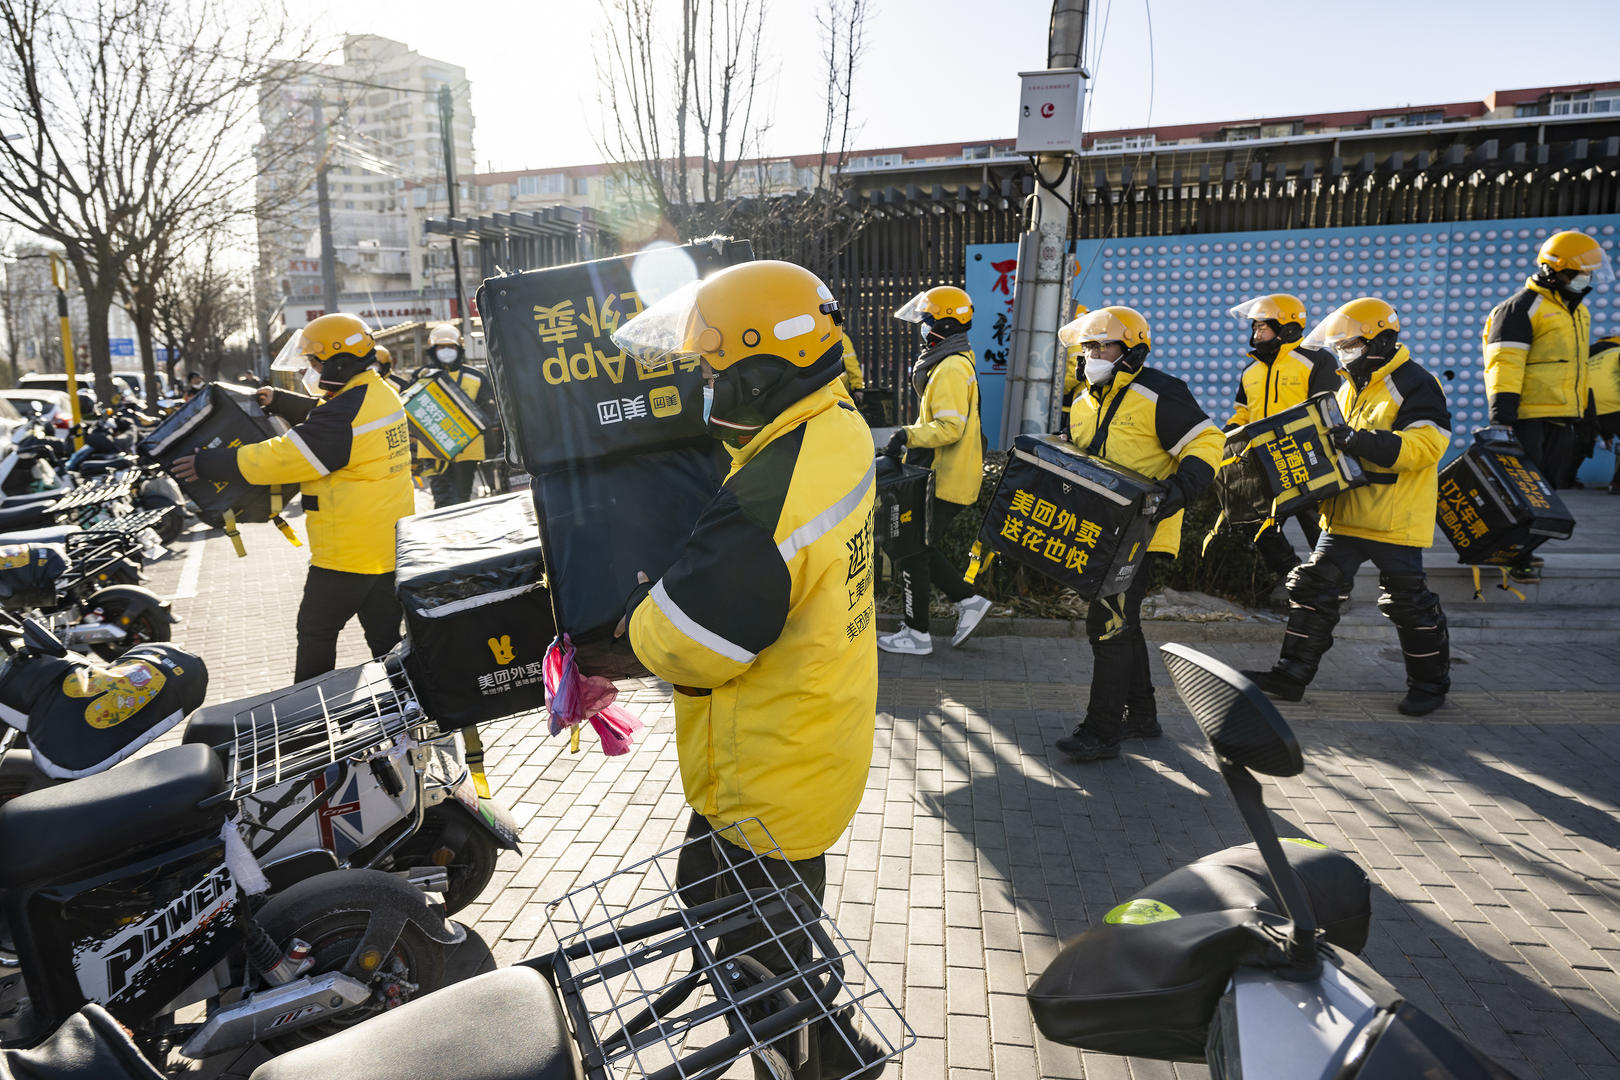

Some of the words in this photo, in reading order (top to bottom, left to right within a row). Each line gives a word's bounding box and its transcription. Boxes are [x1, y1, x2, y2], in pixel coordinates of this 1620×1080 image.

[289, 260, 320, 272] KTV
[597, 395, 648, 425] 美团
[1265, 440, 1291, 490] 上美团App
[1279, 435, 1310, 485] 订酒店
[1009, 489, 1103, 549] 美团外卖
[1437, 491, 1471, 548] 美团App
[1441, 478, 1489, 539] 订火车票
[1000, 514, 1089, 574] 送花也快
[477, 661, 542, 690] 美团外卖
